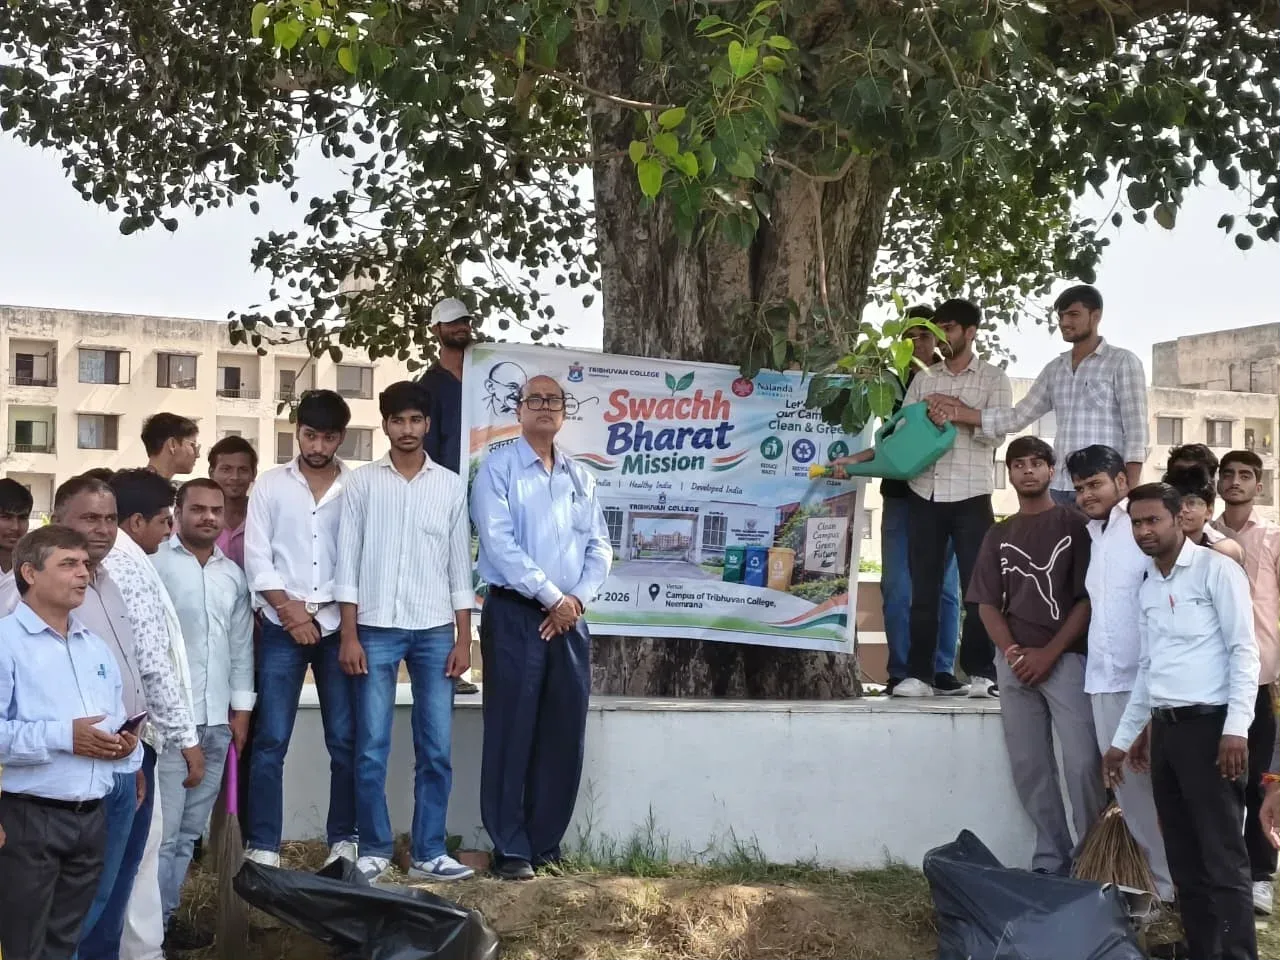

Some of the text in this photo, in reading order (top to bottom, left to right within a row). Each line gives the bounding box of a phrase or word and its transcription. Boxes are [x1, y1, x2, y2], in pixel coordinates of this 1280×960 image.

[588, 366, 629, 376] TRIBHUVAN
[630, 369, 660, 378] COLLEGE
[757, 381, 793, 393] Nalanda
[603, 388, 731, 422] Swachh
[785, 400, 807, 409] Let'
[797, 410, 823, 420] Cam
[768, 421, 843, 435] Clean & Gree
[606, 420, 735, 456] Bharat
[620, 452, 705, 475] Mission
[629, 480, 673, 491] Healthy India
[691, 482, 743, 495] Developed India
[629, 503, 666, 511] TRIBHUVAN
[668, 504, 700, 513] COLLEGE
[604, 592, 630, 602] 2026
[665, 591, 777, 609] Campus of Tribhuvan College,
[665, 601, 703, 609] Neemrana
